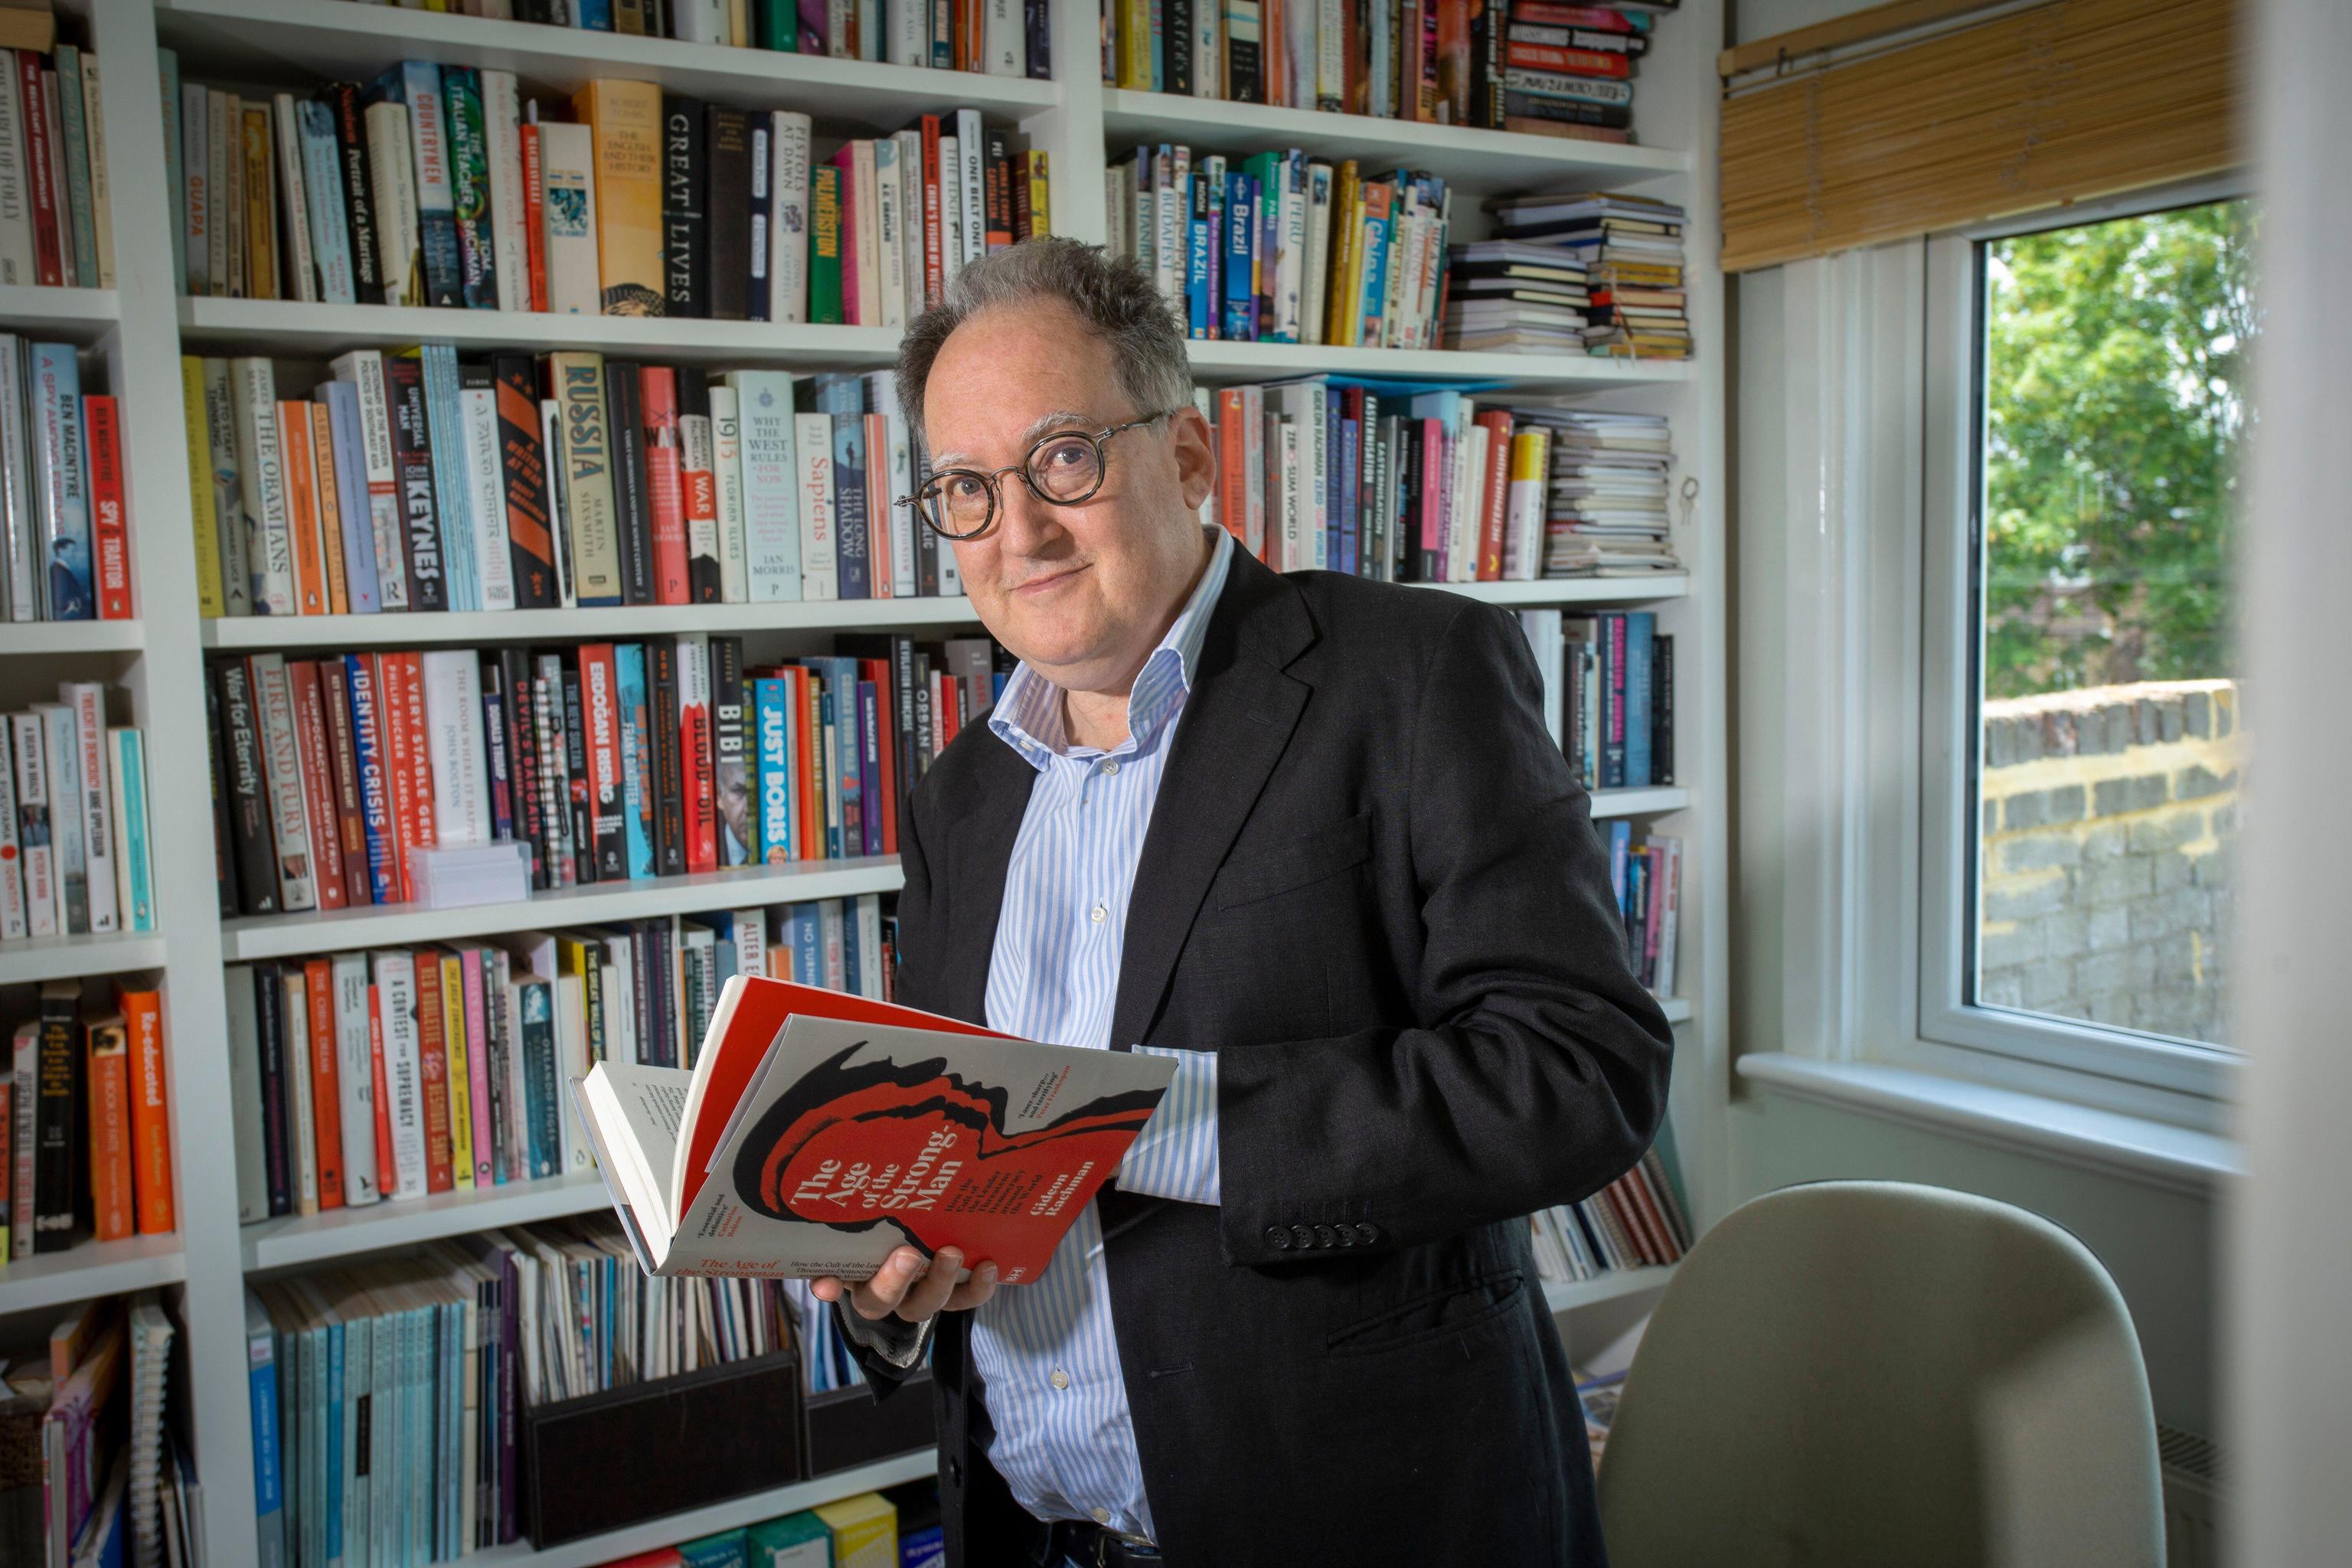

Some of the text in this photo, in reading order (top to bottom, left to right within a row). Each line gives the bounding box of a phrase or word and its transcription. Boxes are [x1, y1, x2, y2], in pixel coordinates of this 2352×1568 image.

[417, 94, 443, 185] COUNTRYMEN
[451, 87, 475, 204] ITALIAN TEACHER
[470, 133, 482, 152] THE
[782, 124, 795, 190] AT DAWN
[795, 126, 808, 192] PISTOLS
[348, 149, 363, 197] Portrait
[969, 156, 981, 248] ONE BELT ONE
[189, 176, 204, 237] GUAPA
[668, 114, 691, 304] GREAT LIVES
[816, 169, 838, 256] PALMERSTON
[1161, 193, 1176, 270] BUDAPEST
[1232, 204, 1250, 255] Brazil
[1289, 201, 1304, 245] PERU
[355, 227, 377, 285] Marriage
[462, 220, 482, 287] RACHMAN
[479, 237, 495, 272] TOM
[1194, 224, 1208, 285] BRAZIL
[41, 358, 54, 368] A
[41, 373, 58, 405] SPY
[60, 394, 80, 499] BEN MACINTYRE
[564, 367, 605, 482] RUSSIA
[716, 417, 737, 459] 1913
[748, 439, 789, 451] WEST
[753, 416, 782, 426] WHY
[754, 429, 781, 438] THE
[750, 452, 789, 462] RULES
[258, 410, 289, 574] THE OBAMIANS
[695, 476, 710, 514] WAR
[807, 456, 830, 542] Sapiens
[1285, 495, 1298, 541] WORLD
[100, 500, 123, 589] SPY TRAITOR
[405, 481, 440, 580] KEYNES
[580, 492, 595, 558] SIXSMITH
[592, 498, 606, 552] MARTIN
[840, 486, 854, 558] SHADOW
[854, 518, 867, 559] LONG
[753, 566, 796, 577] MORRIS
[763, 555, 783, 564] IAN
[226, 667, 257, 796] War for Eternity
[265, 670, 303, 836] FIRE AND FURY
[352, 671, 387, 828] IDENTITY CRISIS
[387, 665, 410, 812] PHILIP RUCKER CAROL
[405, 665, 431, 798] A VERY STABLE
[589, 662, 615, 805] ERDOĞAN RISING
[717, 705, 744, 764] BIBI
[443, 726, 462, 808] JOHN BOLTON
[521, 757, 541, 835] BARGAIN
[691, 717, 714, 828] BLOOD OIL
[762, 705, 789, 844] JUST BORIS
[744, 923, 760, 959] ALTER
[803, 923, 815, 943] NO
[139, 1011, 162, 1107] Re-educated
[396, 1061, 415, 1127] SUPREMACY
[790, 1158, 841, 1205] The
[825, 1161, 871, 1208] Age
[862, 1163, 900, 1209] of the
[880, 1125, 957, 1209] Strong-
[906, 1160, 963, 1211] Man
[1030, 1174, 1070, 1216] Gideon
[1044, 1161, 1095, 1217] Rachman
[715, 1194, 724, 1210] and
[718, 1205, 739, 1237] Catherine
[727, 1215, 743, 1238] Belton
[674, 1268, 785, 1278] the Strongman
[701, 1258, 781, 1271] The Age of
